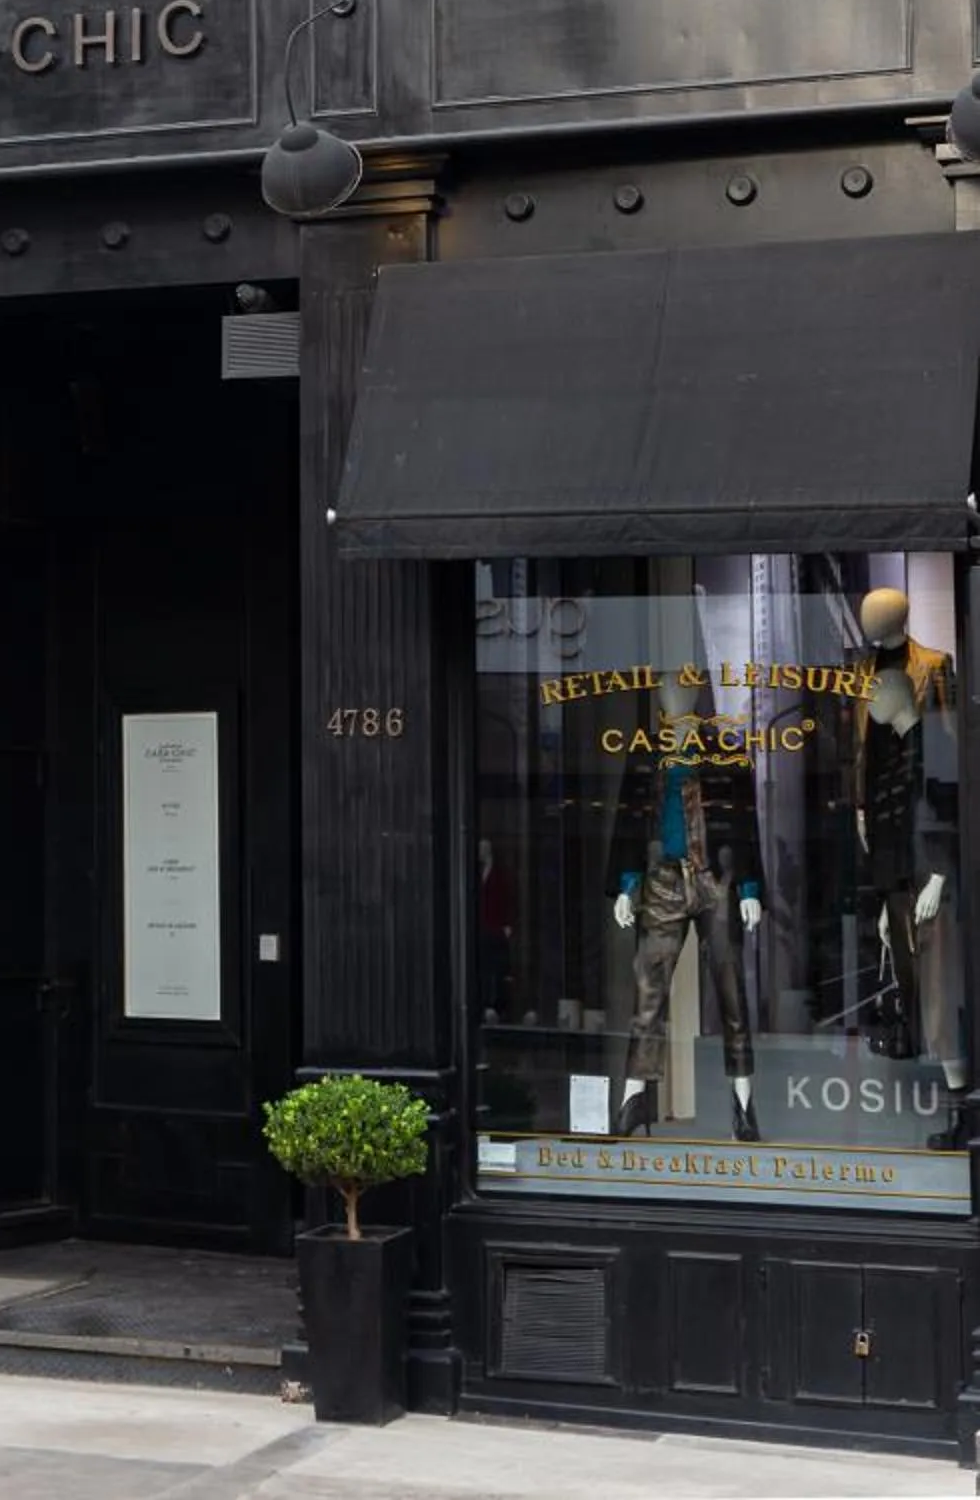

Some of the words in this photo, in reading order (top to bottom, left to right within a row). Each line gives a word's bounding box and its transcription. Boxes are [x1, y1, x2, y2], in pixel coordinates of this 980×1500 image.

[539, 663, 665, 706] RETAIL
[678, 661, 706, 689] &
[720, 660, 883, 704] LEISURE
[326, 707, 404, 738] 4786
[786, 1075, 939, 1116] KOSIU
[537, 1146, 584, 1170] Bed
[597, 1148, 615, 1170] &
[774, 1156, 897, 1185] Palermo
